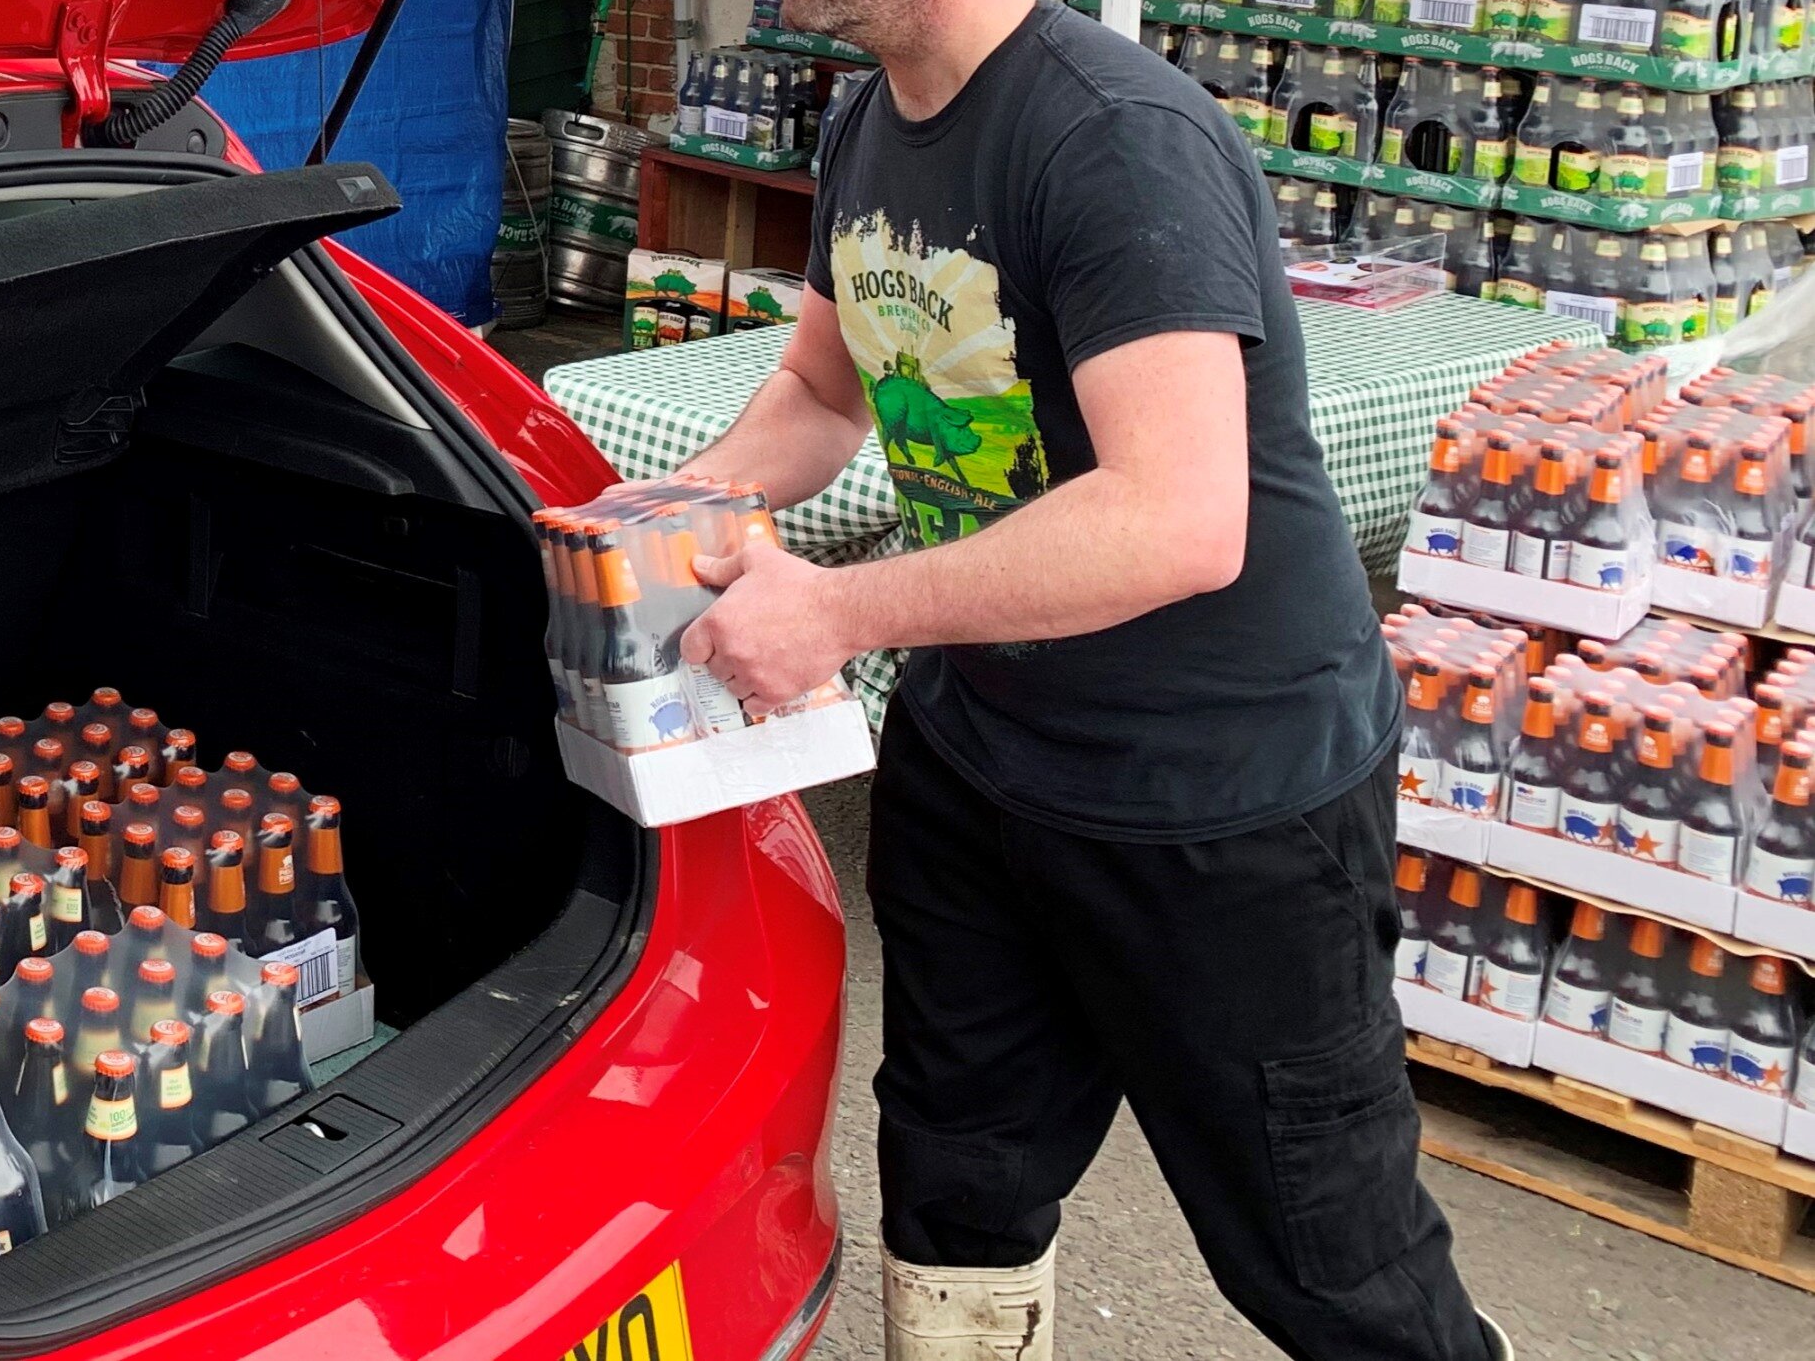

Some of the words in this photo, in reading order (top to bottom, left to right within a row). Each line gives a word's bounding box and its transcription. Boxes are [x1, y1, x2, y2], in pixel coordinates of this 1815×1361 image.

[1143, 0, 1156, 15] CK
[1247, 14, 1274, 28] HOGS
[1275, 14, 1303, 33] BACK
[1401, 33, 1430, 47] HOGS
[1432, 34, 1463, 54] BACK
[1571, 52, 1603, 68] HOGS
[1605, 53, 1641, 75] BACK
[1313, 117, 1327, 126] TEA
[700, 143, 720, 153] HOGS
[720, 144, 740, 160] BACK
[1481, 143, 1499, 151] TEA
[1561, 154, 1575, 164] TEA
[1564, 197, 1594, 216] BACK
[650, 254, 676, 263] HOGS
[677, 255, 702, 269] BACK
[851, 269, 906, 303] HOGS
[908, 274, 954, 333] BACK
[633, 335, 653, 348] TEA
[924, 474, 968, 499] ENGLISH
[974, 494, 998, 510] ALE
[650, 693, 668, 709] HOGS
